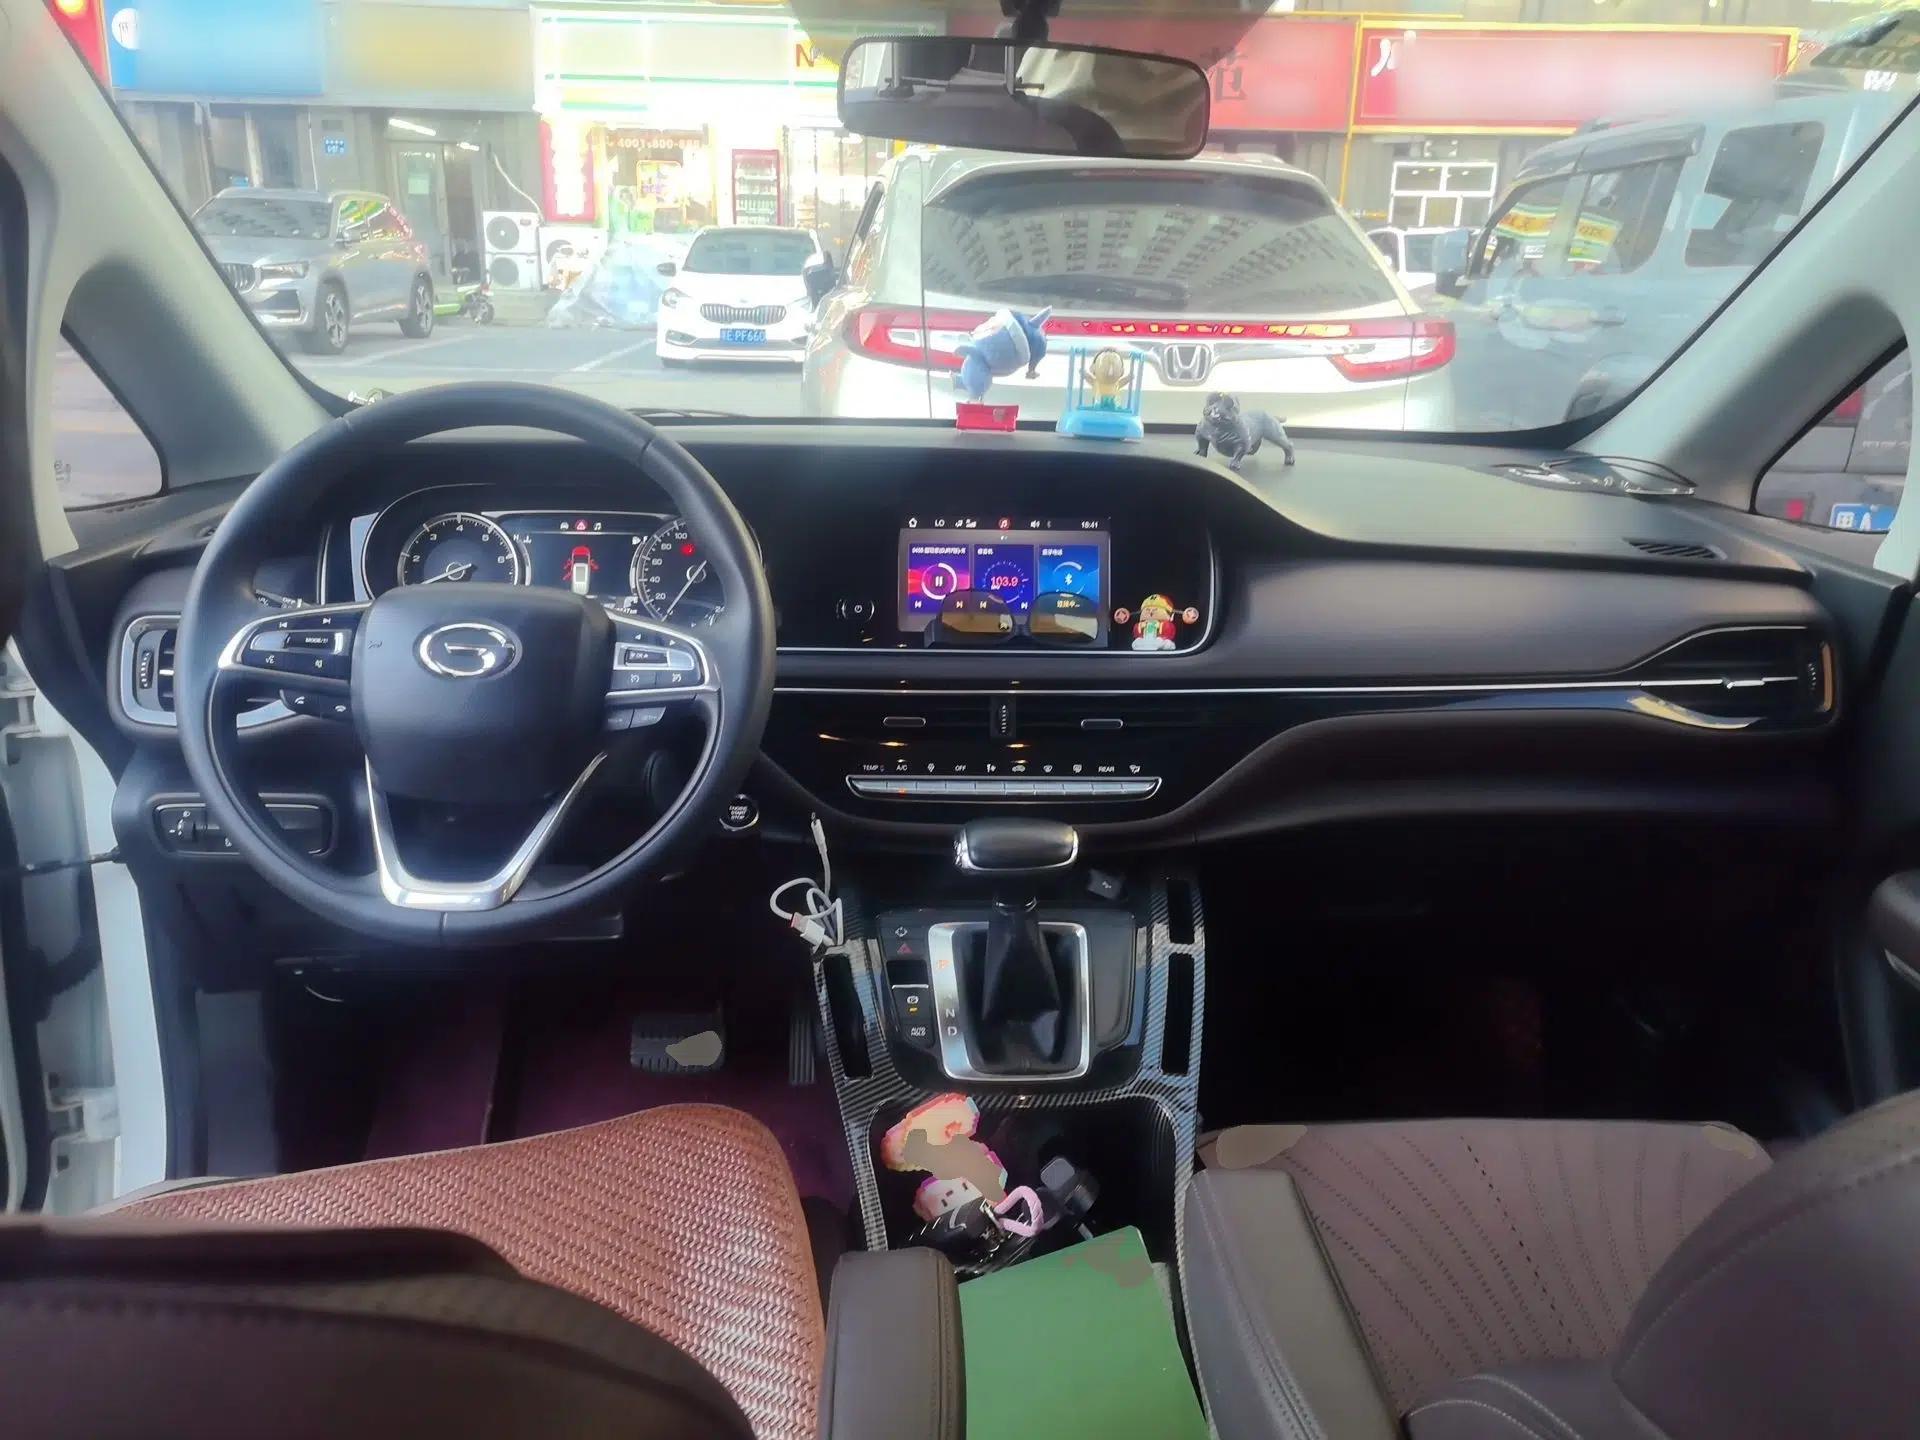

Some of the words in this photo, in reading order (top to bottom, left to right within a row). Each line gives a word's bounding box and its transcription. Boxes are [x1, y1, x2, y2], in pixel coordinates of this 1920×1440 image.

[456, 524, 464, 532] 4
[430, 533, 437, 541] 3
[674, 531, 688, 540] 100
[661, 543, 672, 551] 80
[651, 558, 662, 566] 60
[649, 576, 660, 584] 40
[655, 592, 666, 600] 20
[896, 764, 908, 772] A/C
[945, 1008, 956, 1018] N
[947, 1026, 958, 1037] D
